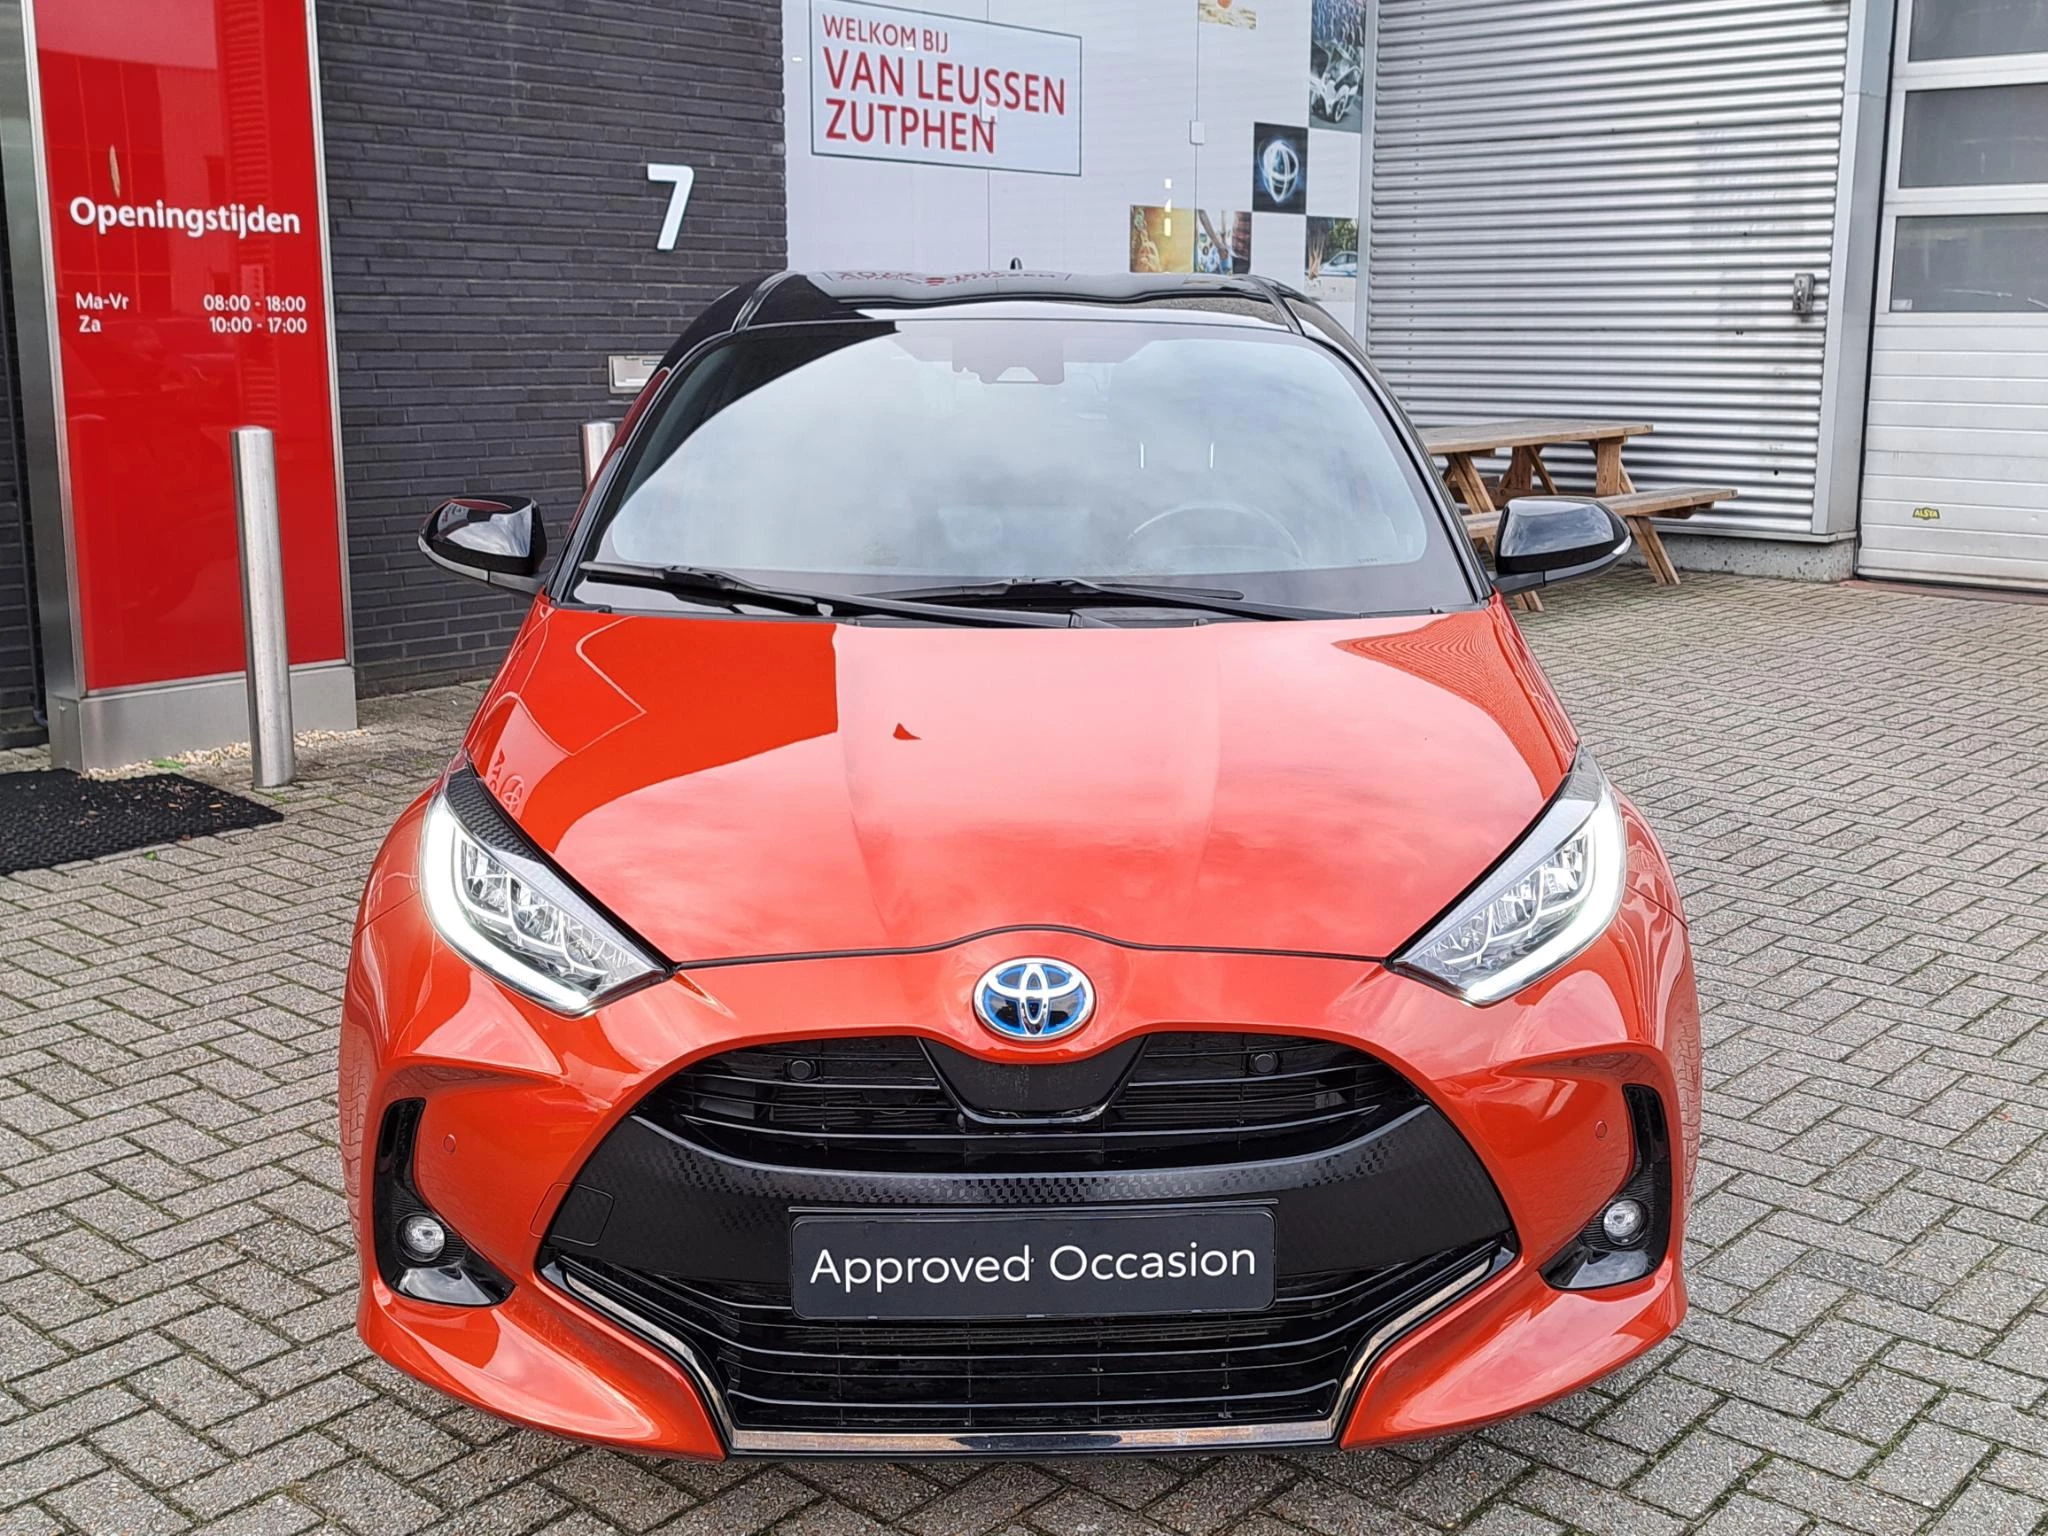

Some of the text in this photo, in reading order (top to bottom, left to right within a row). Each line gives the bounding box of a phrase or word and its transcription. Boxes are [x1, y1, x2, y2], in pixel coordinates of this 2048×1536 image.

[822, 14, 949, 54] WELKOM BIJ
[822, 46, 1065, 116] VAN LEUSSEN
[825, 97, 995, 154] ZUTPHEN
[69, 196, 301, 240] Openingstijden
[647, 163, 694, 250] 7
[75, 291, 130, 310] Ma-Vr
[203, 294, 251, 312] 08:00
[265, 295, 307, 313] 18:00
[78, 315, 102, 333] Za
[209, 316, 252, 333] 10:00
[267, 317, 308, 334] 17:00
[809, 1241, 1256, 1294] Approved Occasion
